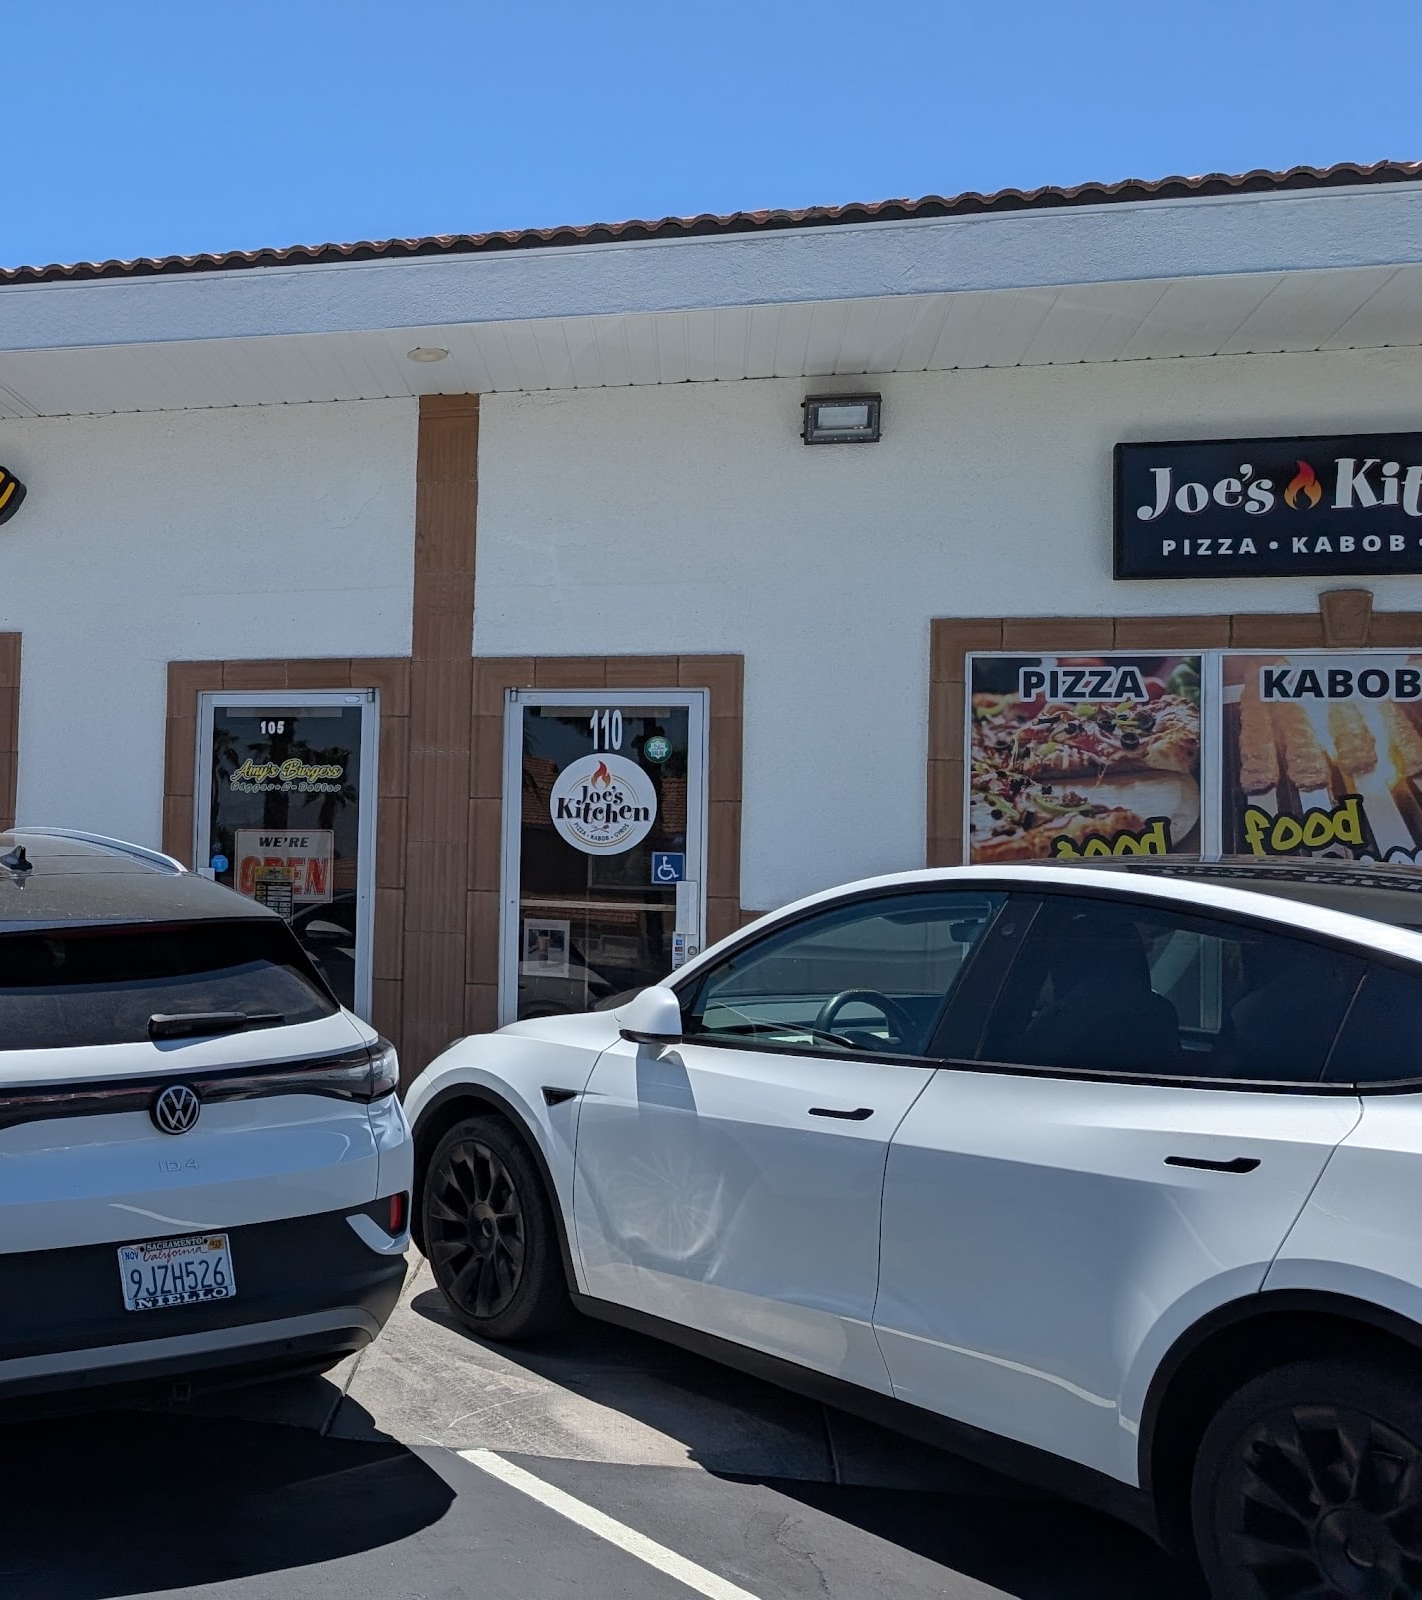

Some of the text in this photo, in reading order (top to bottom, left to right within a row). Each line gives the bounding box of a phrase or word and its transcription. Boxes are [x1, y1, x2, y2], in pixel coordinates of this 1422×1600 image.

[1136, 463, 1275, 521] Joe's
[1162, 534, 1406, 556] PIZZA KABOB
[1021, 668, 1146, 700] PIZZA
[1262, 667, 1422, 700] KABOB
[260, 720, 285, 734] 105
[590, 709, 623, 750] 110
[230, 757, 343, 783] Amy's Burgers
[580, 785, 624, 805] Joe's
[556, 797, 650, 824] Kitchen
[1244, 799, 1366, 857] food
[259, 836, 309, 848] WE'RE
[239, 855, 329, 895] OEN
[125, 1251, 139, 1261] NOV
[142, 1246, 208, 1263] California
[146, 1238, 202, 1251] SACRAMENTO
[130, 1257, 226, 1299] 9JZH526
[136, 1287, 227, 1309] NIELLO
